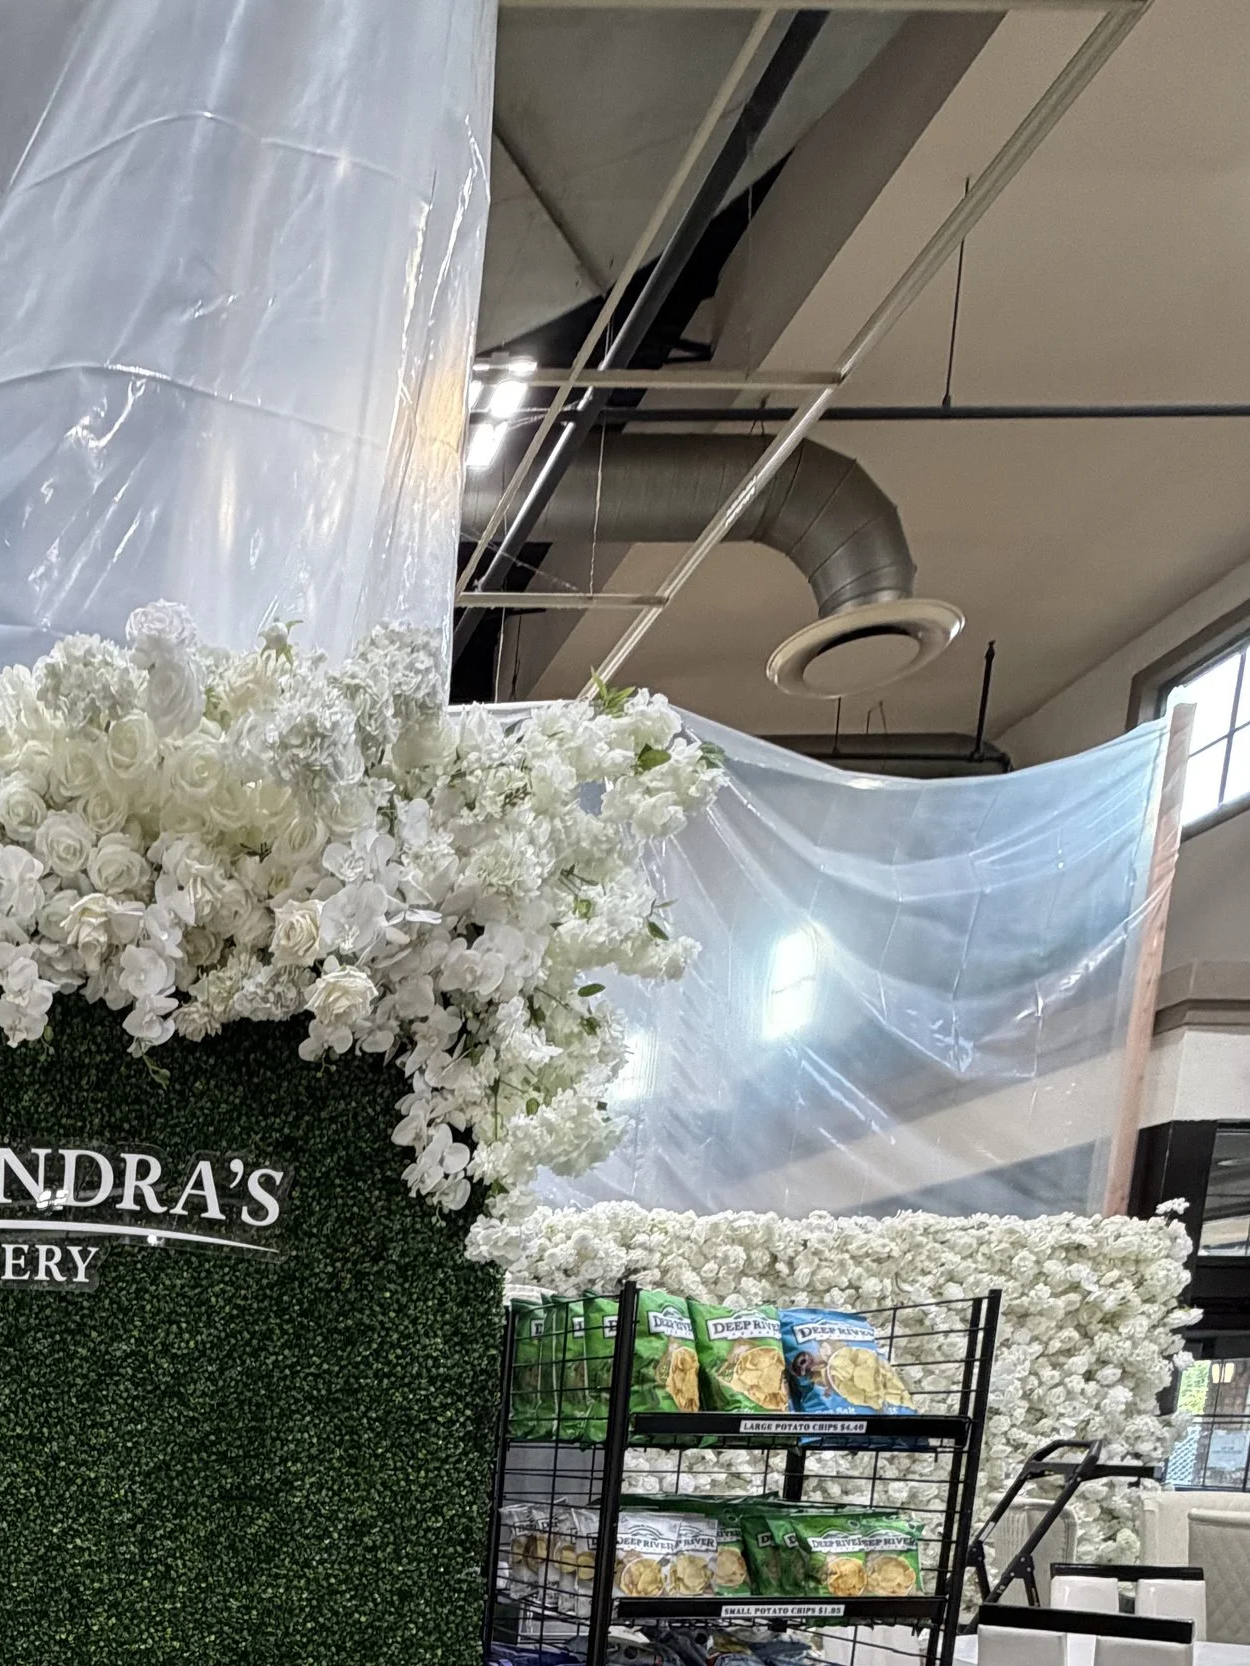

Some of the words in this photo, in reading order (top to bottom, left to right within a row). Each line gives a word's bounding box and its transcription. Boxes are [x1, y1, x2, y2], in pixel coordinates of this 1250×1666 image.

[713, 1321, 750, 1336] DEEP
[750, 1319, 781, 1333] RIVE
[799, 1325, 834, 1340] DEEP
[743, 1423, 773, 1431] LARGE
[775, 1423, 810, 1431] POTATO
[812, 1423, 838, 1431] CHIPS
[683, 1538, 715, 1548] RIVER
[812, 1538, 835, 1549] DEEP
[835, 1538, 861, 1548] RIVE
[861, 1538, 882, 1547] EEP
[724, 1607, 752, 1616] SMALL
[754, 1607, 789, 1615] POTATO
[790, 1606, 816, 1615] CHIPS
